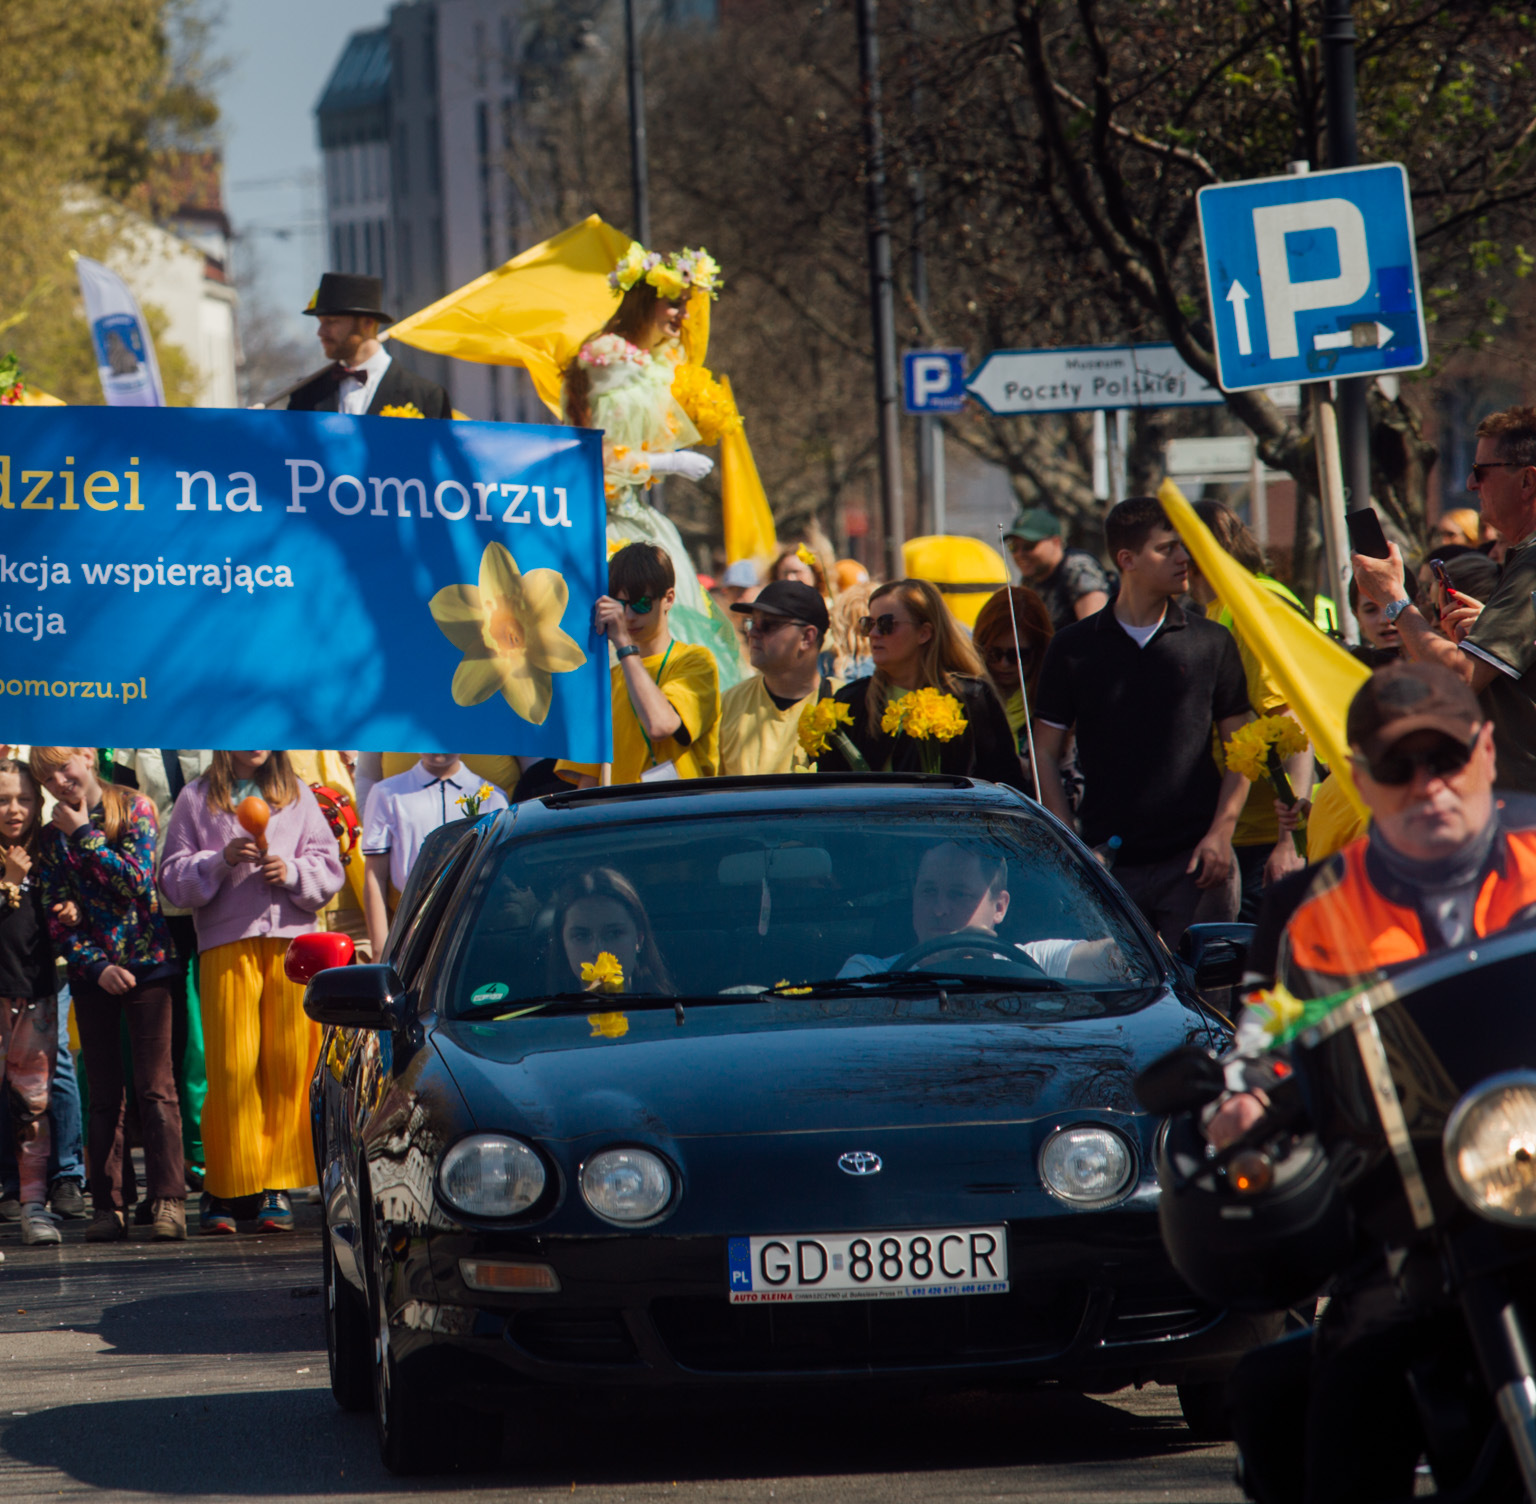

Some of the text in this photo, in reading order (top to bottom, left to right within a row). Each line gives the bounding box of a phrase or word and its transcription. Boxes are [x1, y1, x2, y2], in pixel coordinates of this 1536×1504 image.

[1252, 198, 1371, 360] P
[1065, 358, 1125, 370] Museum
[913, 357, 951, 407] P
[1004, 371, 1186, 404] Poczty Polskiej
[175, 470, 263, 513] na
[284, 458, 574, 528] Pomorzu
[81, 563, 295, 595] wspierająca
[760, 1232, 999, 1286] GD 888CR
[732, 1270, 750, 1284] PL
[734, 1294, 758, 1302] AUTO
[761, 1292, 793, 1302] KLEINA
